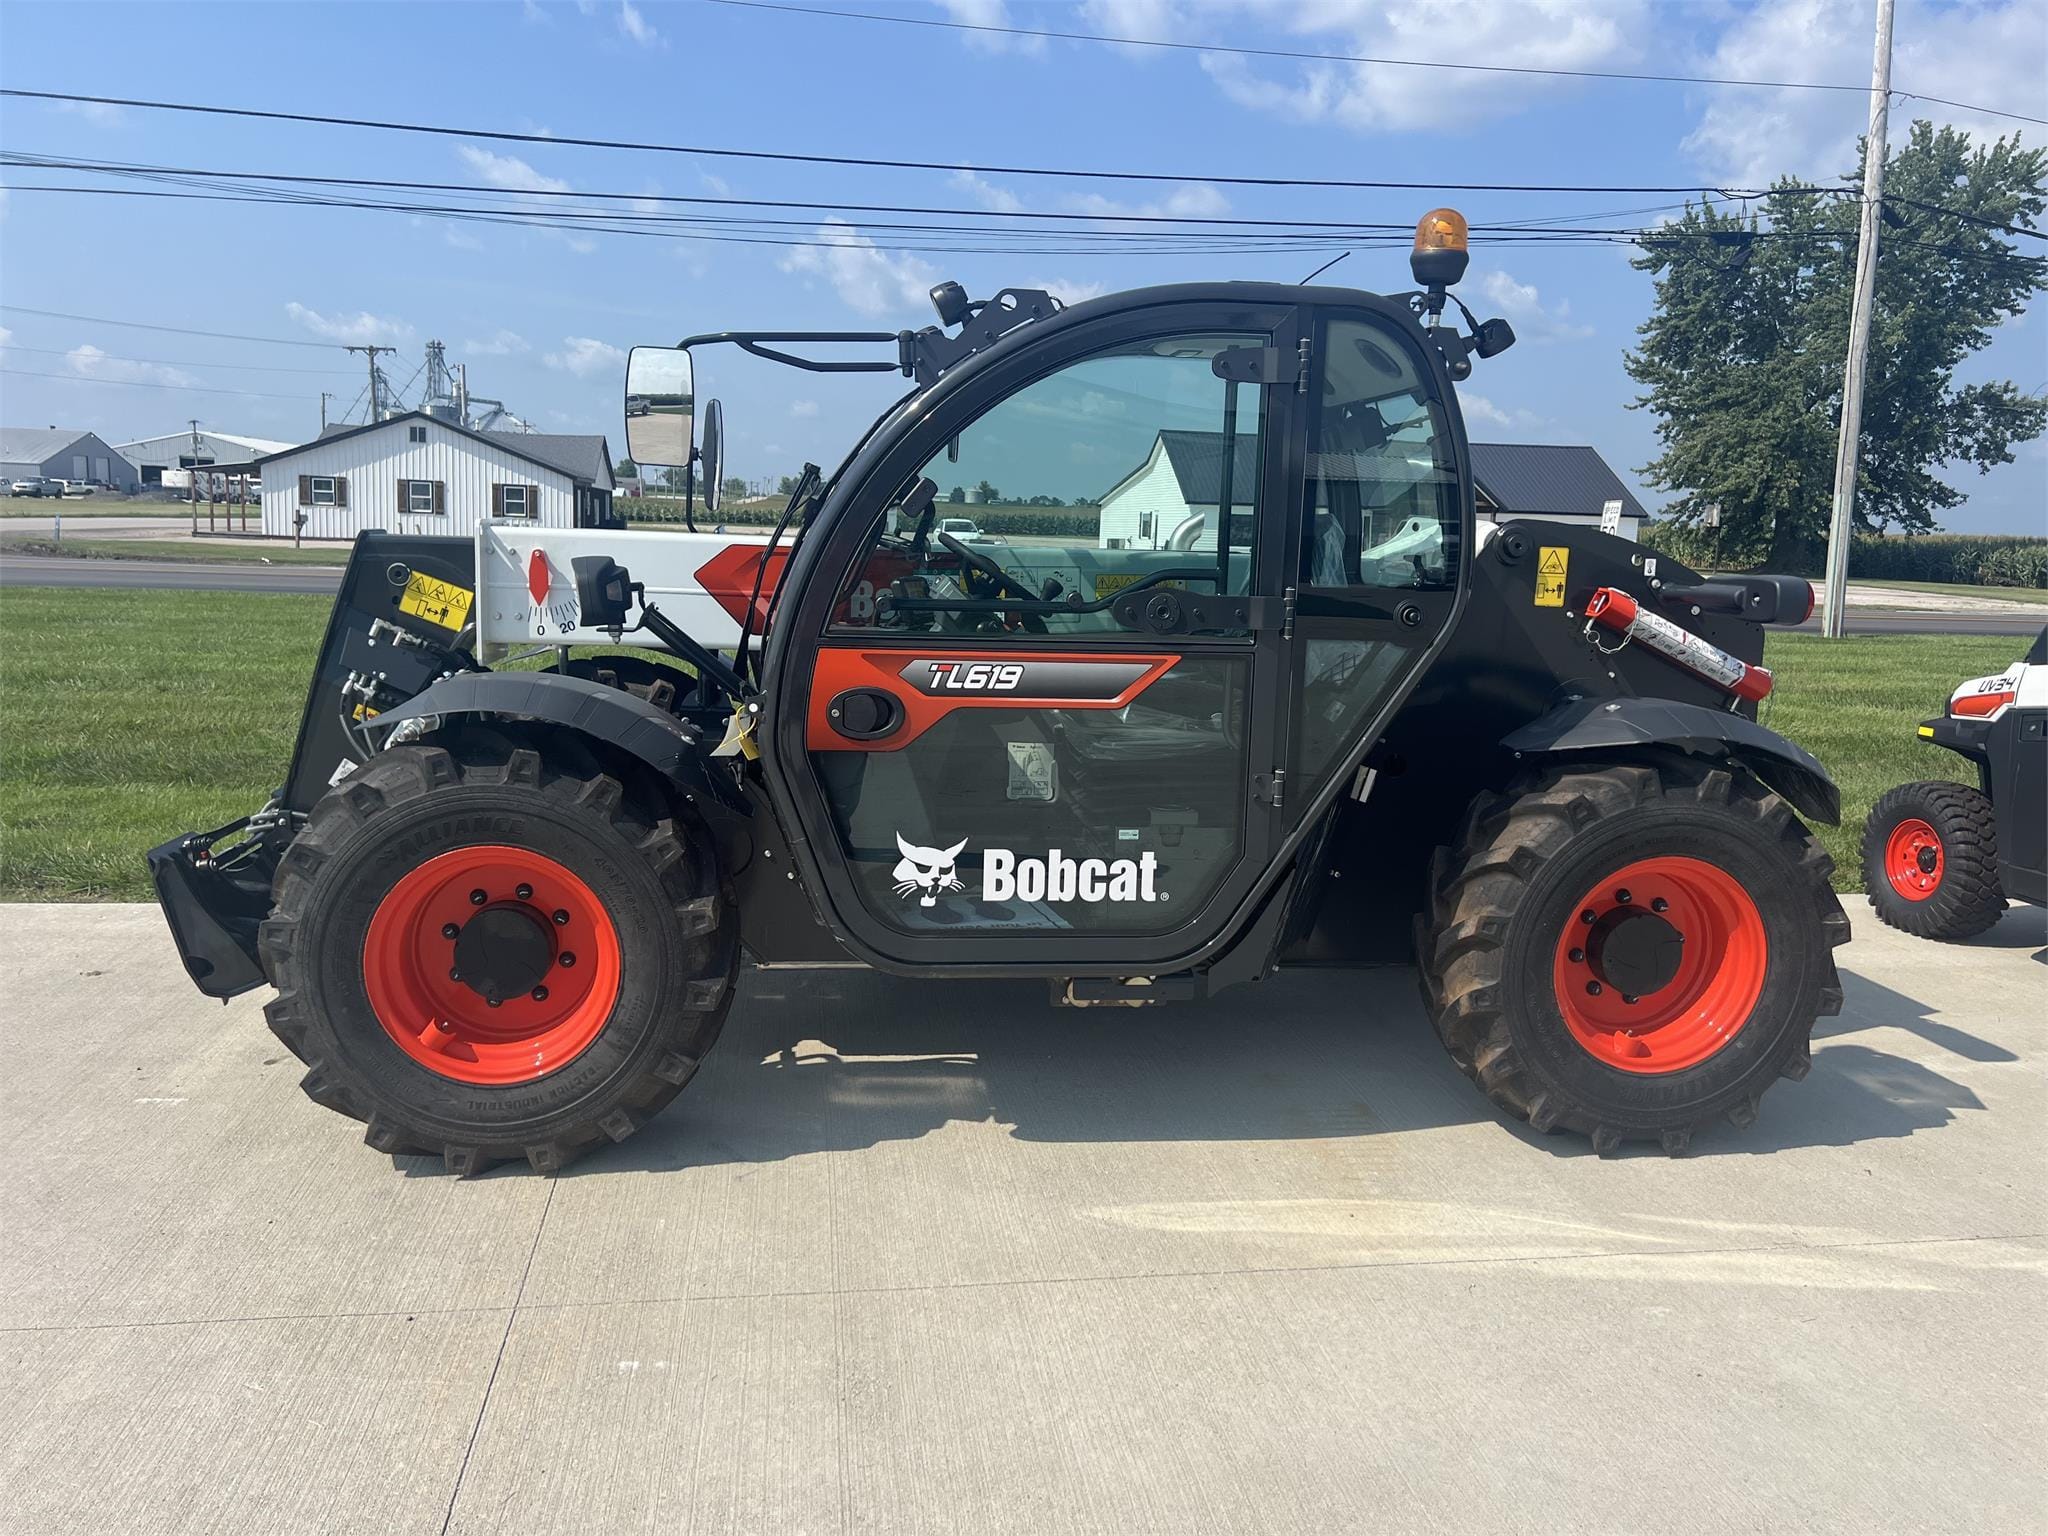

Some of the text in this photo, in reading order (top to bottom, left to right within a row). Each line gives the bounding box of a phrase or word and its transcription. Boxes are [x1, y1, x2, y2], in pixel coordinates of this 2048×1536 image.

[537, 620, 576, 636] 0 20
[928, 663, 1025, 690] TL619
[1977, 676, 2018, 693] UV34
[982, 848, 1158, 902] Bobcat
